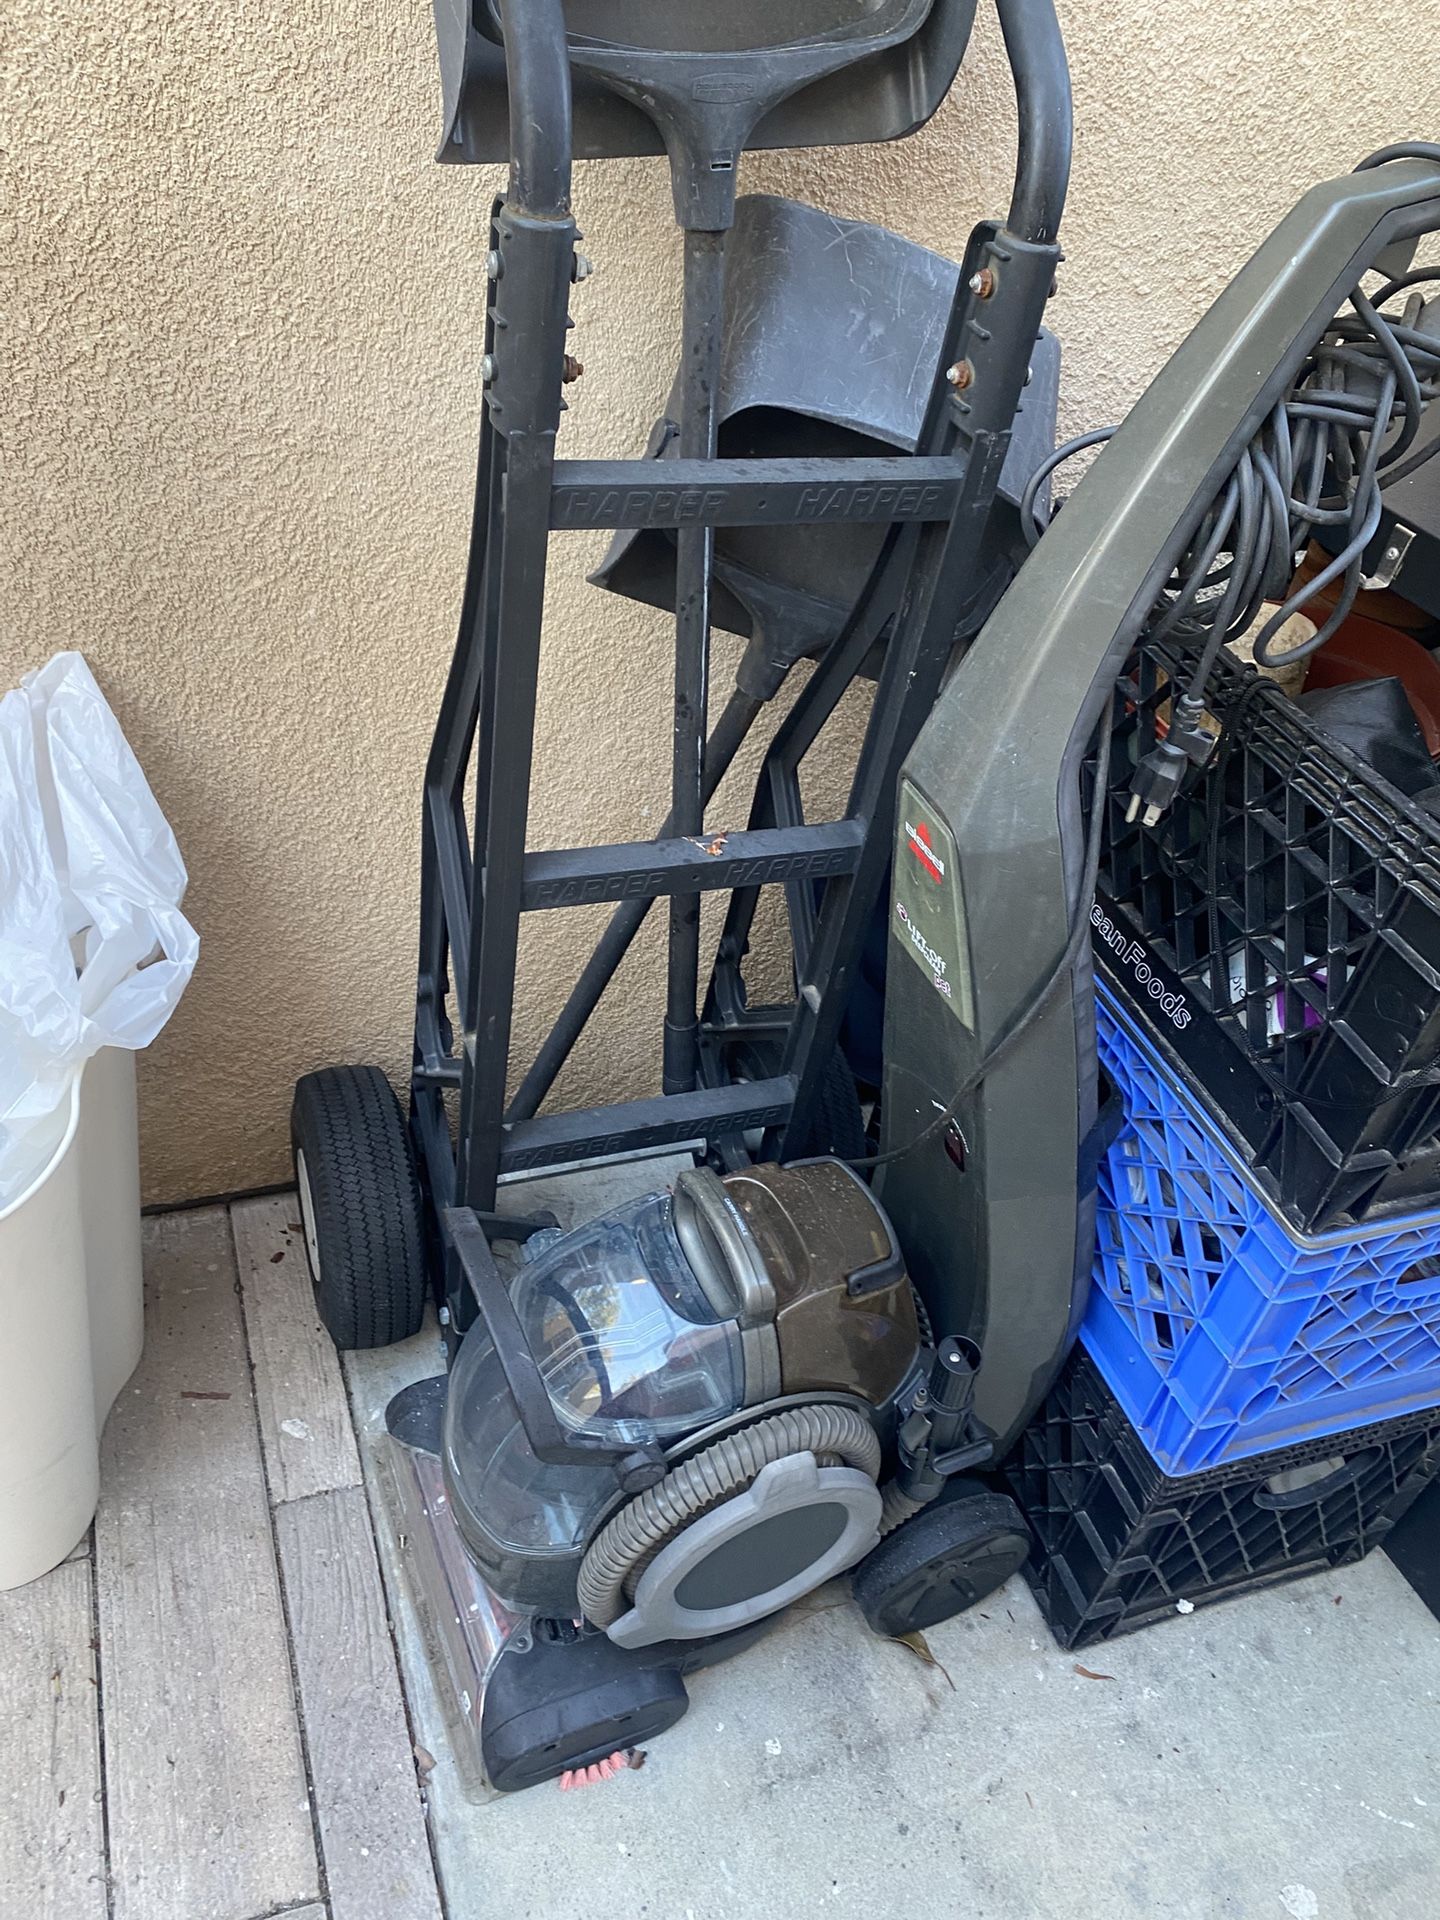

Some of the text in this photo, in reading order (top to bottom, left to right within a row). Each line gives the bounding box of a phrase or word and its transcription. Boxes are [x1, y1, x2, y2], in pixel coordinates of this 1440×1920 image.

[565, 485, 944, 522] HARPER HARPER
[535, 850, 849, 905] HARPER HARPER
[1089, 893, 1192, 1030] eanFoods
[673, 1106, 781, 1140] HARPER
